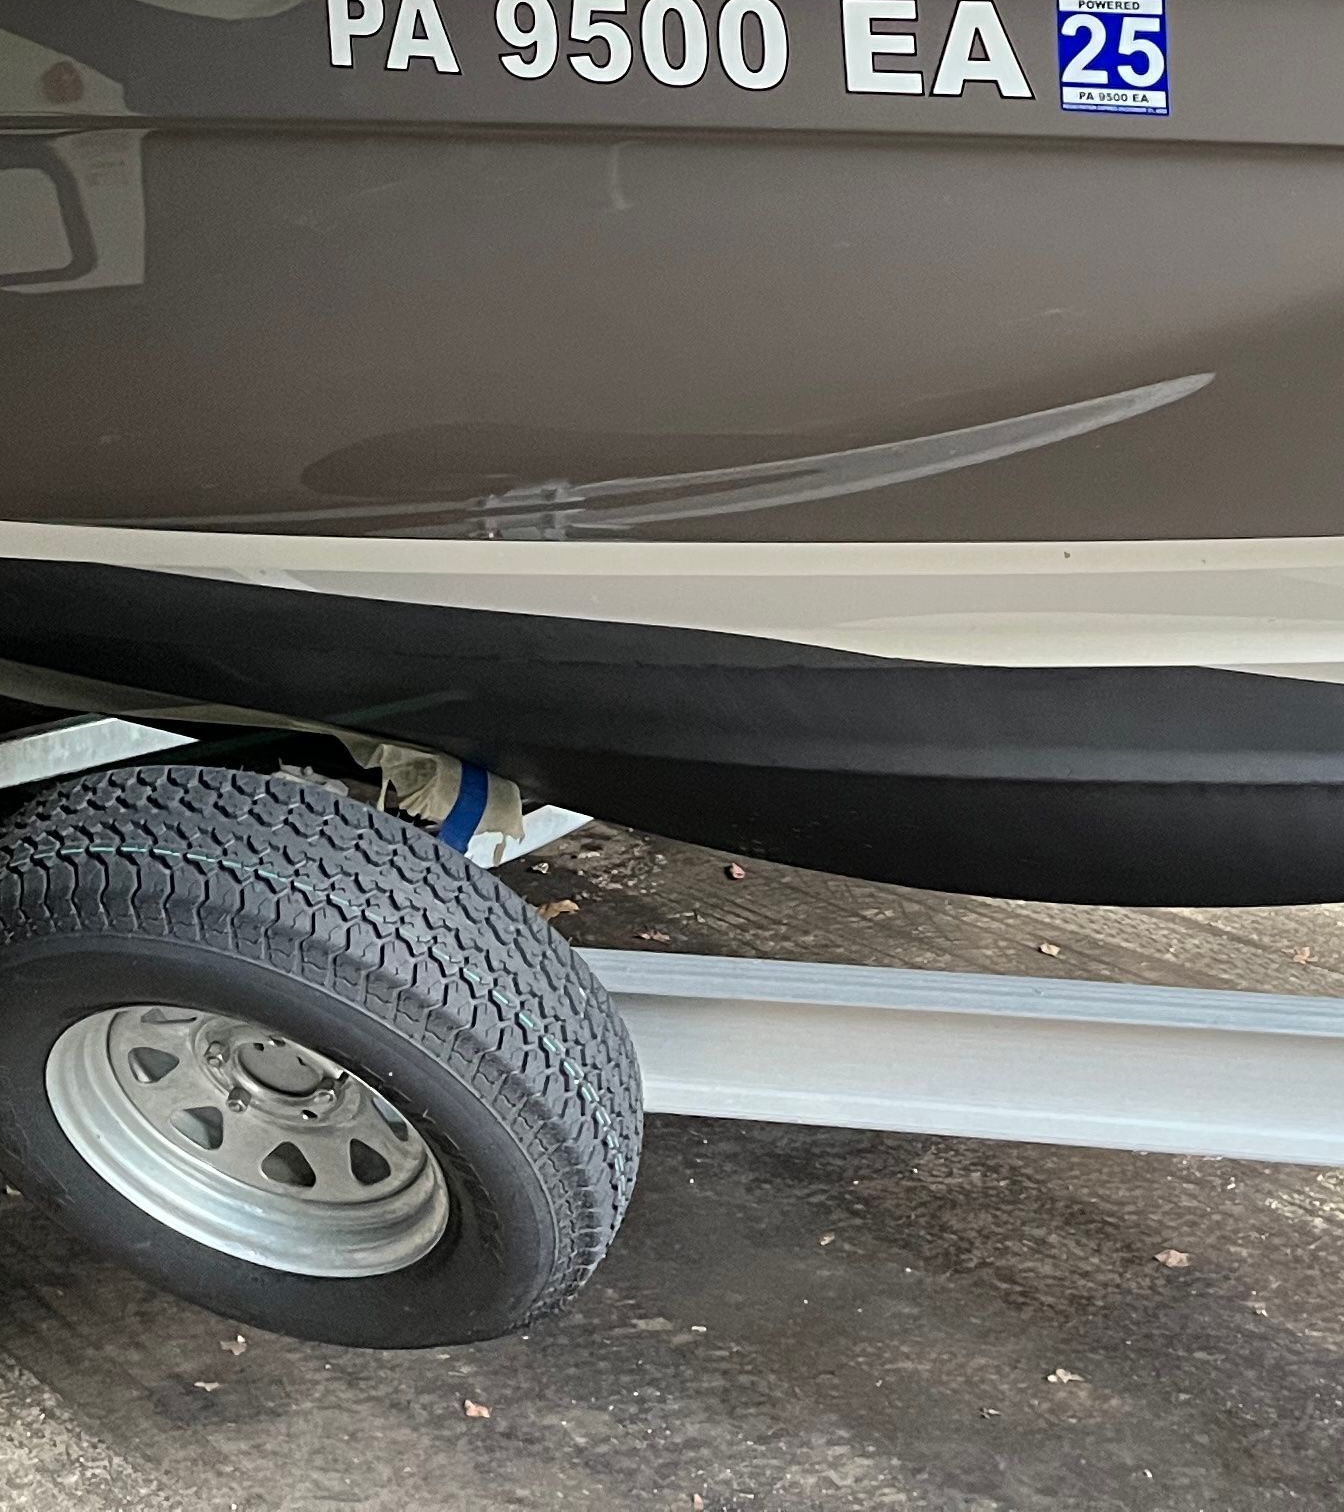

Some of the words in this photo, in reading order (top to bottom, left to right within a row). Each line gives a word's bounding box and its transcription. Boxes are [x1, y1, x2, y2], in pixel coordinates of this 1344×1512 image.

[1078, 0, 1140, 10] POWERED
[1061, 13, 1165, 87] 25
[1079, 92, 1094, 100] PA
[1099, 93, 1128, 102] 9500
[1133, 94, 1149, 102] EA
